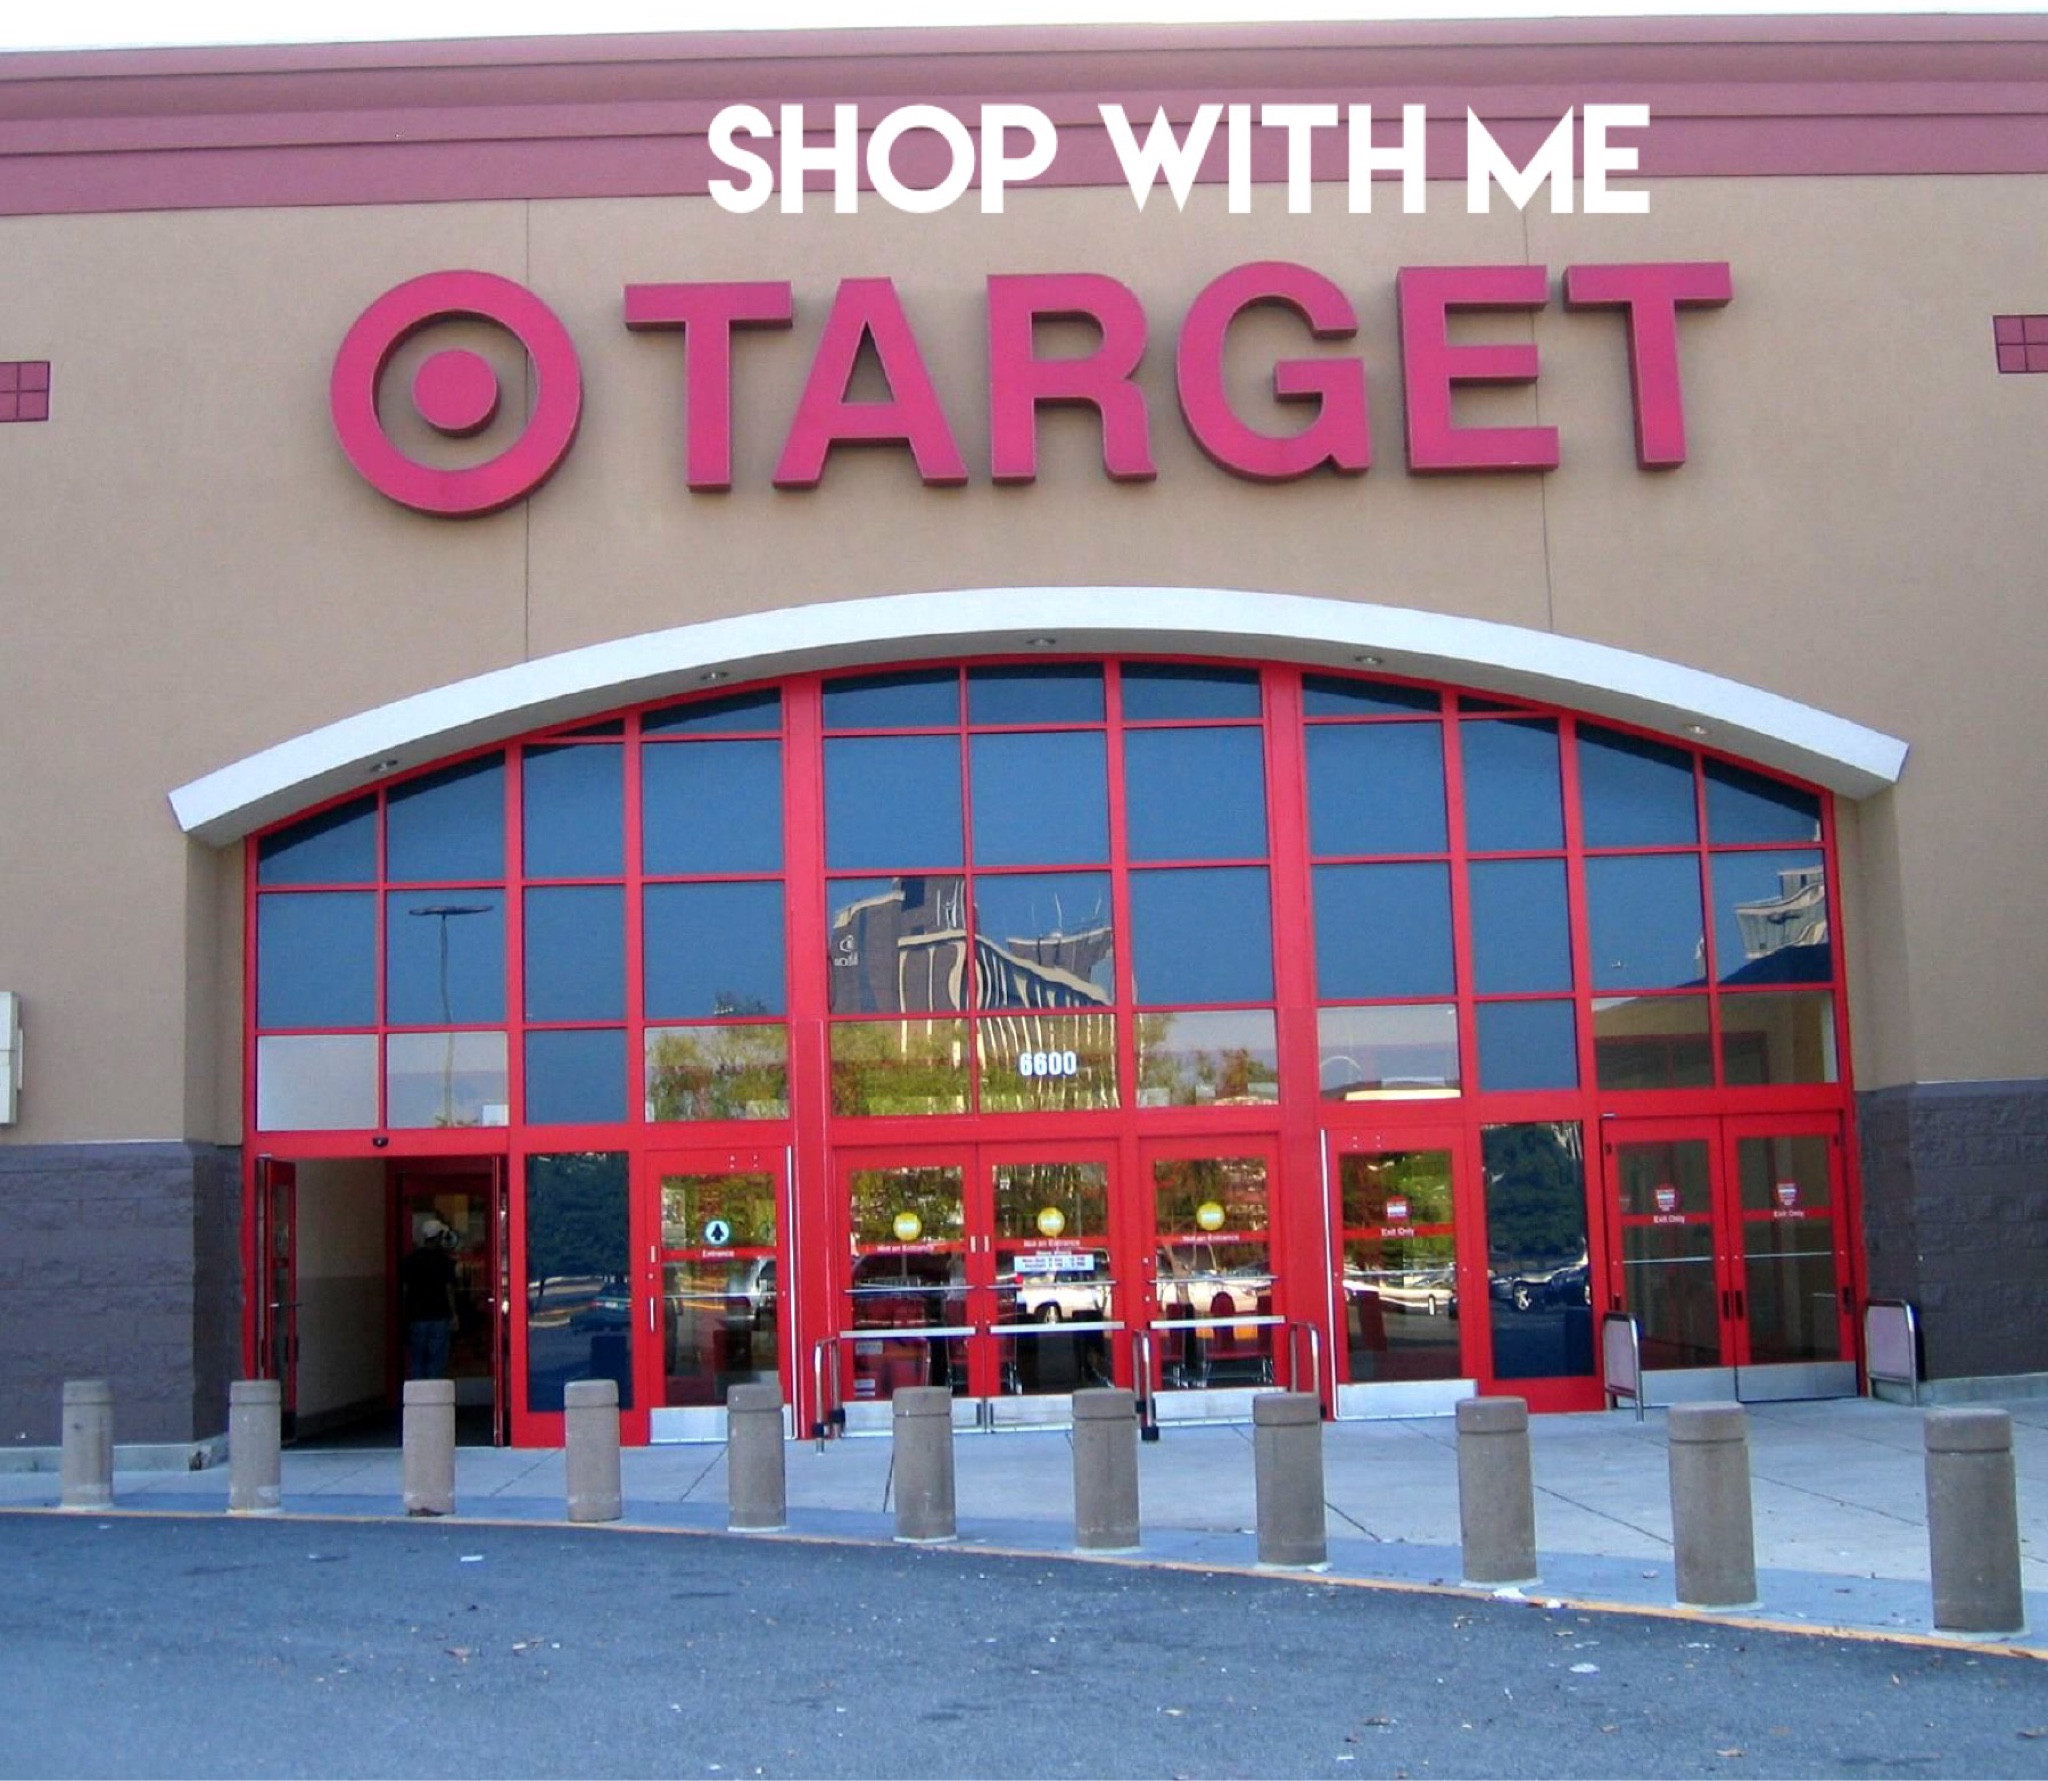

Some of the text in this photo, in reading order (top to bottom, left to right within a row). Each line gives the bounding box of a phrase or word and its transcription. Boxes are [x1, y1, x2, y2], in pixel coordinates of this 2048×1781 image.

[623, 261, 1732, 491] TARGET
[1020, 1051, 1077, 1076] 6600
[1773, 1209, 1787, 1218] Exit
[1653, 1214, 1685, 1225] Exit Only
[1381, 1227, 1414, 1238] Exit Only
